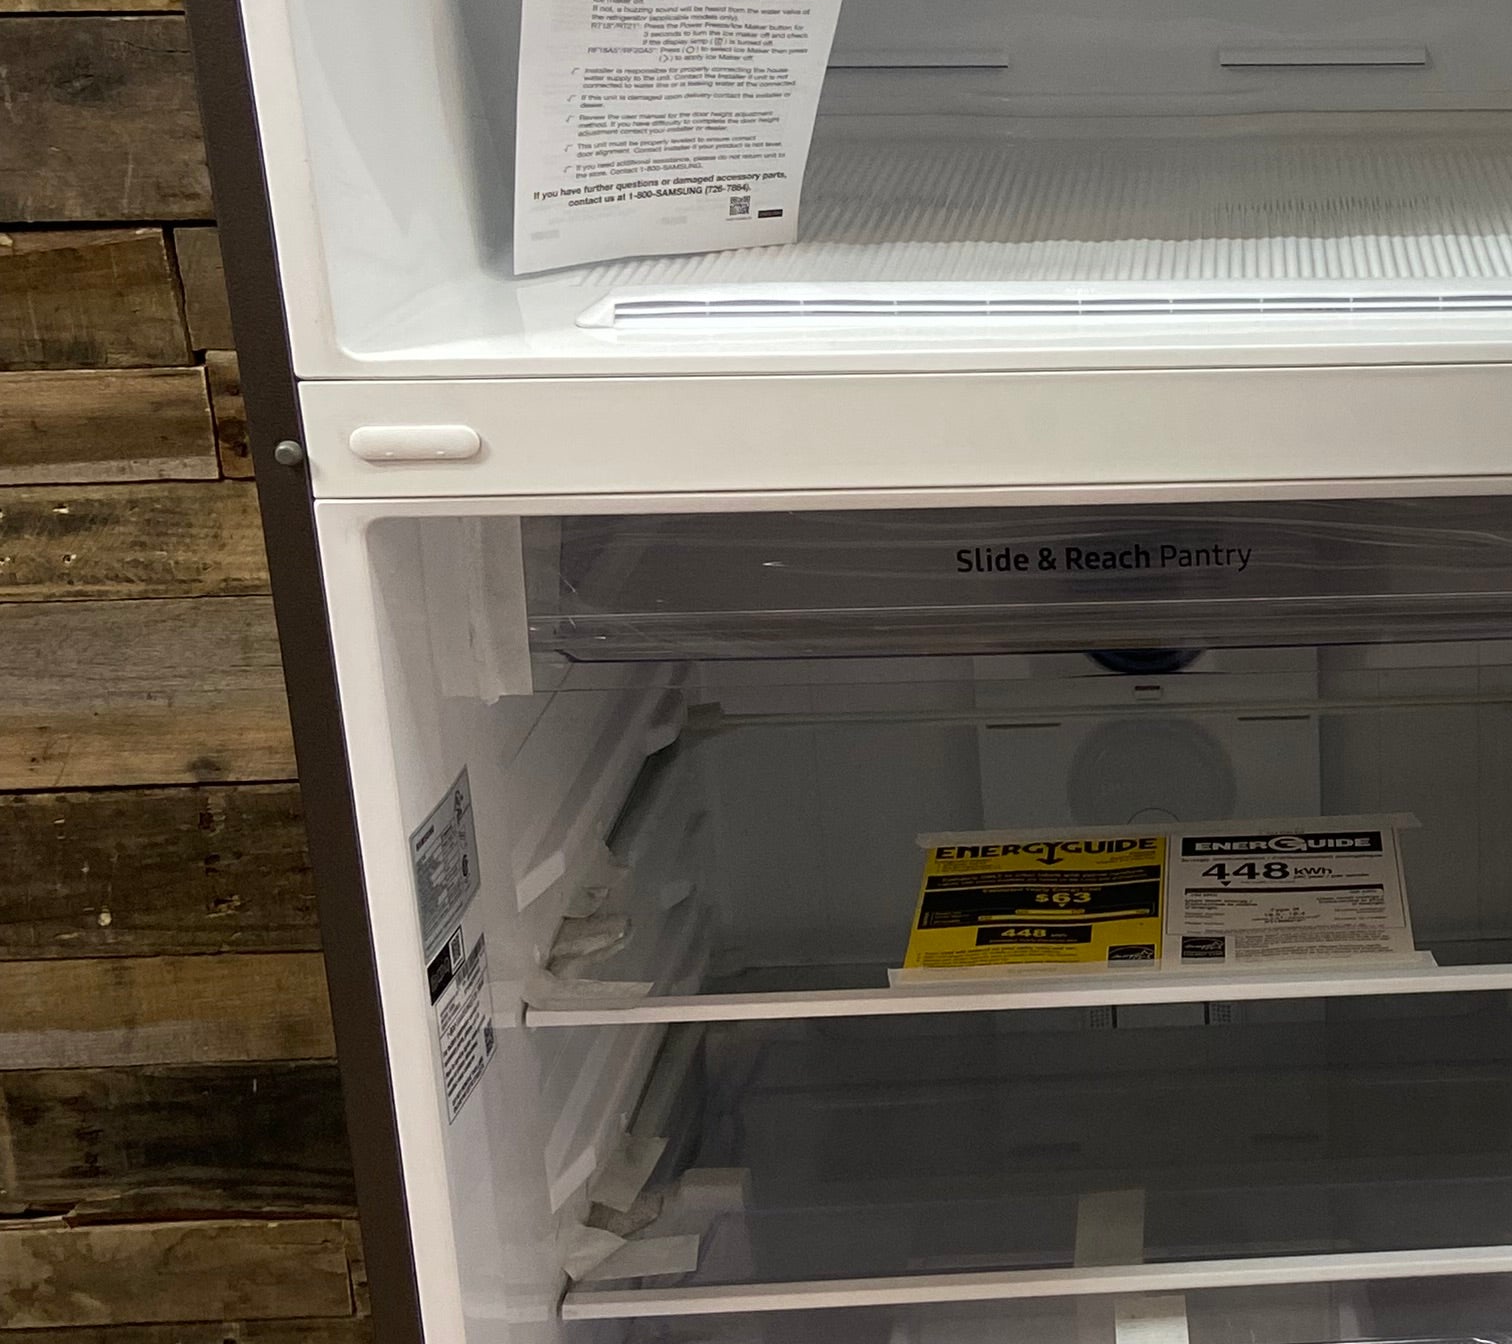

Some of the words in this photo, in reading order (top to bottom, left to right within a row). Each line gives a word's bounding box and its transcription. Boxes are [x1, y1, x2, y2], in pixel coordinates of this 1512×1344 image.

[533, 191, 540, 200] If
[541, 191, 558, 201] you
[560, 187, 582, 196] have
[583, 183, 614, 194] further
[615, 179, 659, 191] questions
[673, 175, 714, 185] damaged
[716, 173, 760, 182] accessory
[762, 172, 787, 181] parts,
[568, 196, 602, 207] contact
[604, 195, 615, 203] us
[617, 193, 626, 201] at
[629, 187, 702, 200] 1-800-SAMSUNG
[956, 547, 1029, 573] Slide
[1038, 547, 1057, 570] &
[1065, 544, 1151, 570] Reach
[1160, 543, 1252, 573] Pantry
[935, 837, 1158, 864] ENERGYGUIDE
[1202, 862, 1290, 880] 448
[1294, 867, 1333, 875] kWh
[1034, 891, 1092, 904] $63
[1001, 928, 1047, 938] 448
